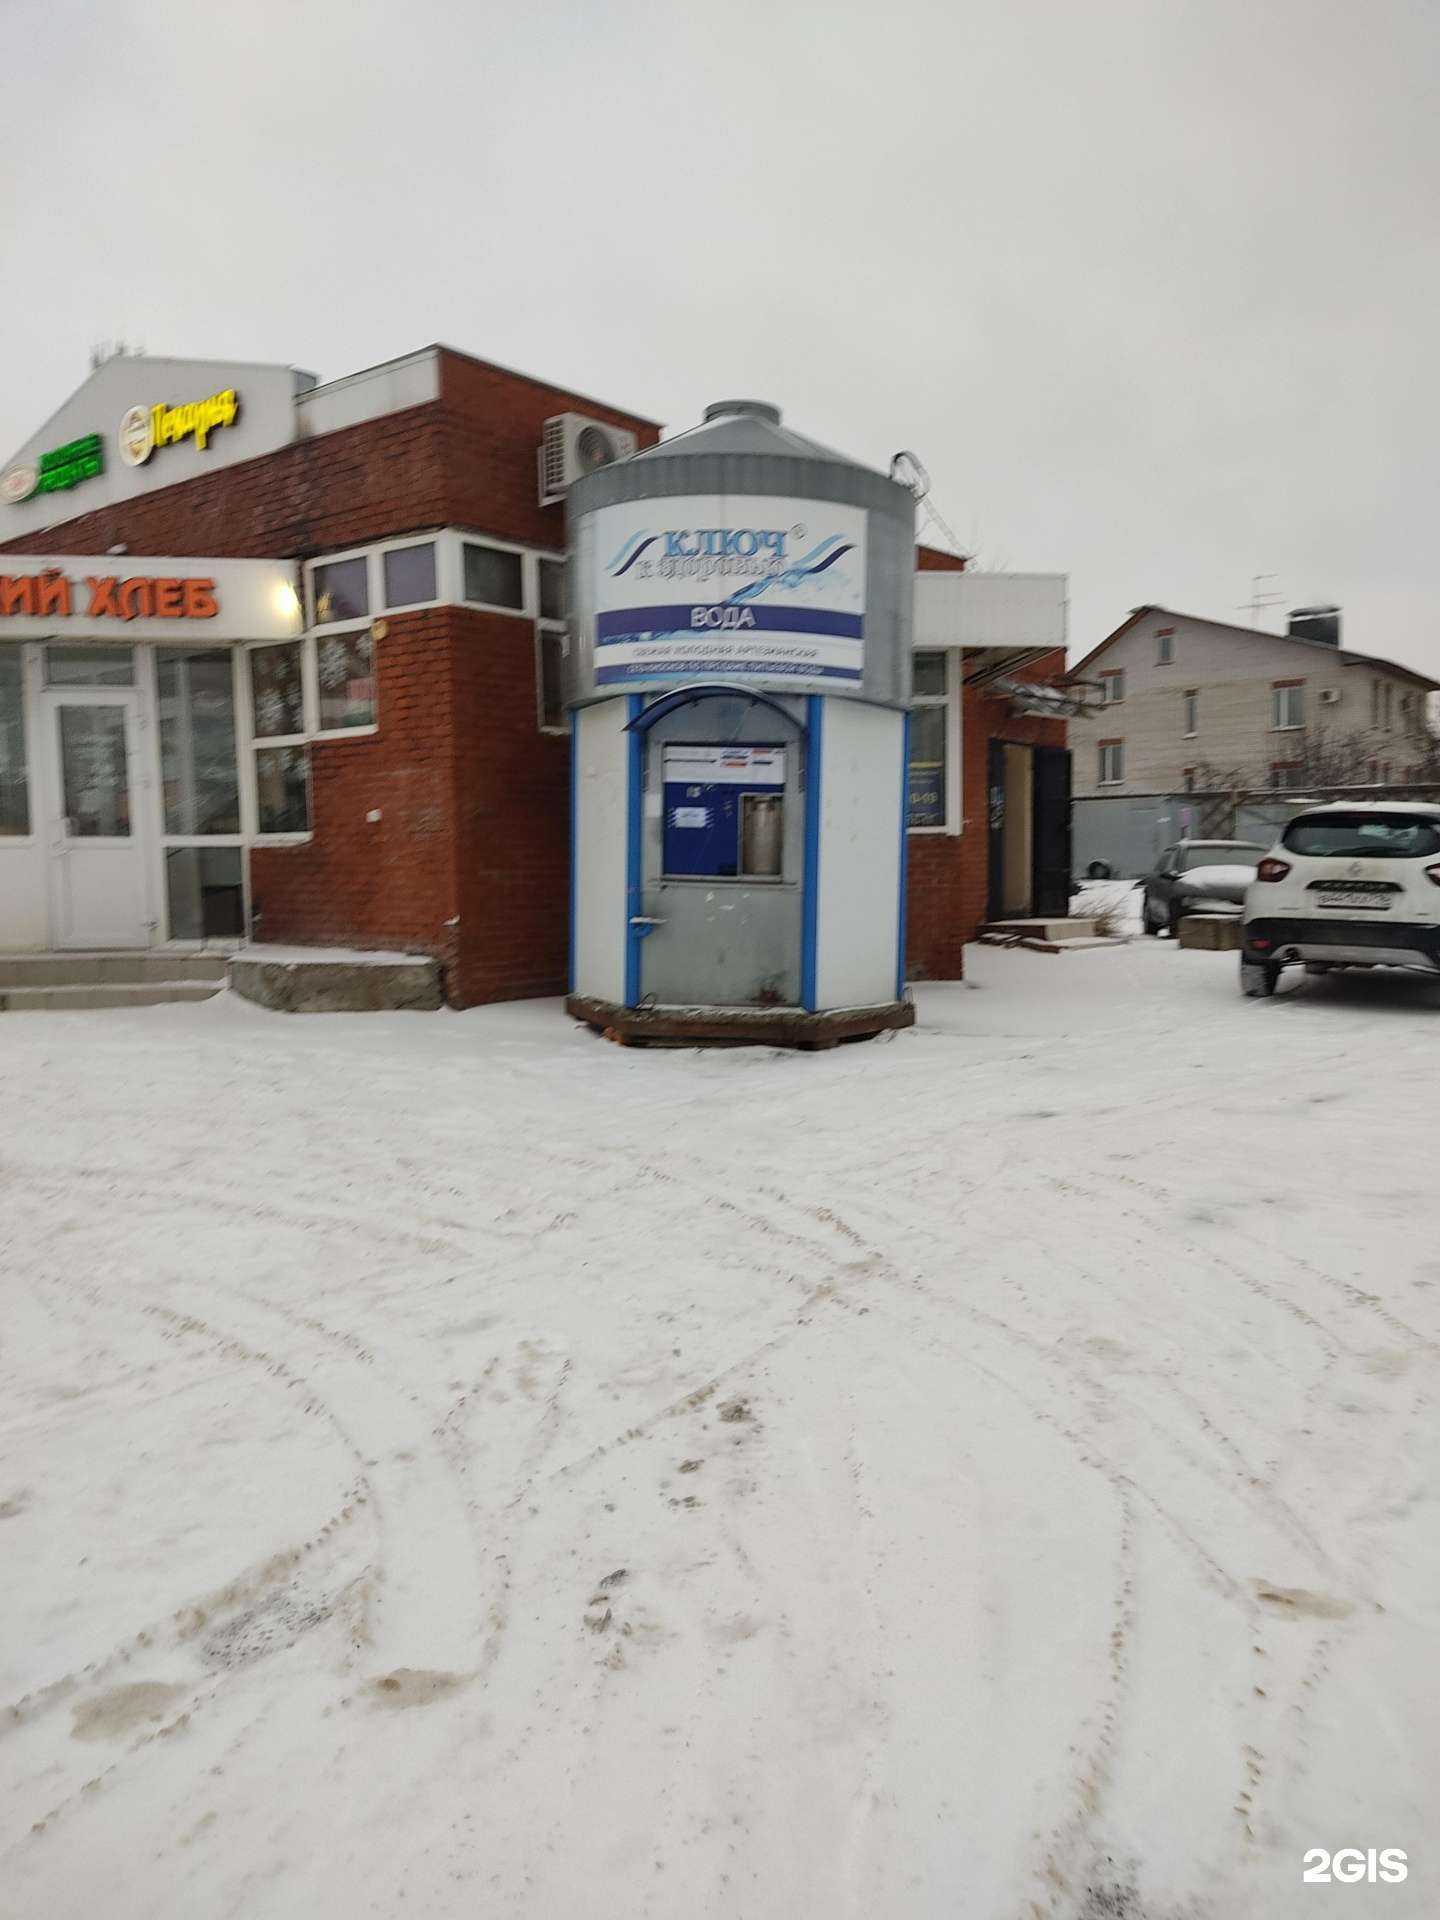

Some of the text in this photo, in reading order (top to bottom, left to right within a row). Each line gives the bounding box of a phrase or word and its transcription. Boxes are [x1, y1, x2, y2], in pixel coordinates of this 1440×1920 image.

[663, 528, 788, 558] КЛЮЧ
[85, 576, 220, 621] ХЛЕБ
[690, 606, 757, 630] ВОДА
